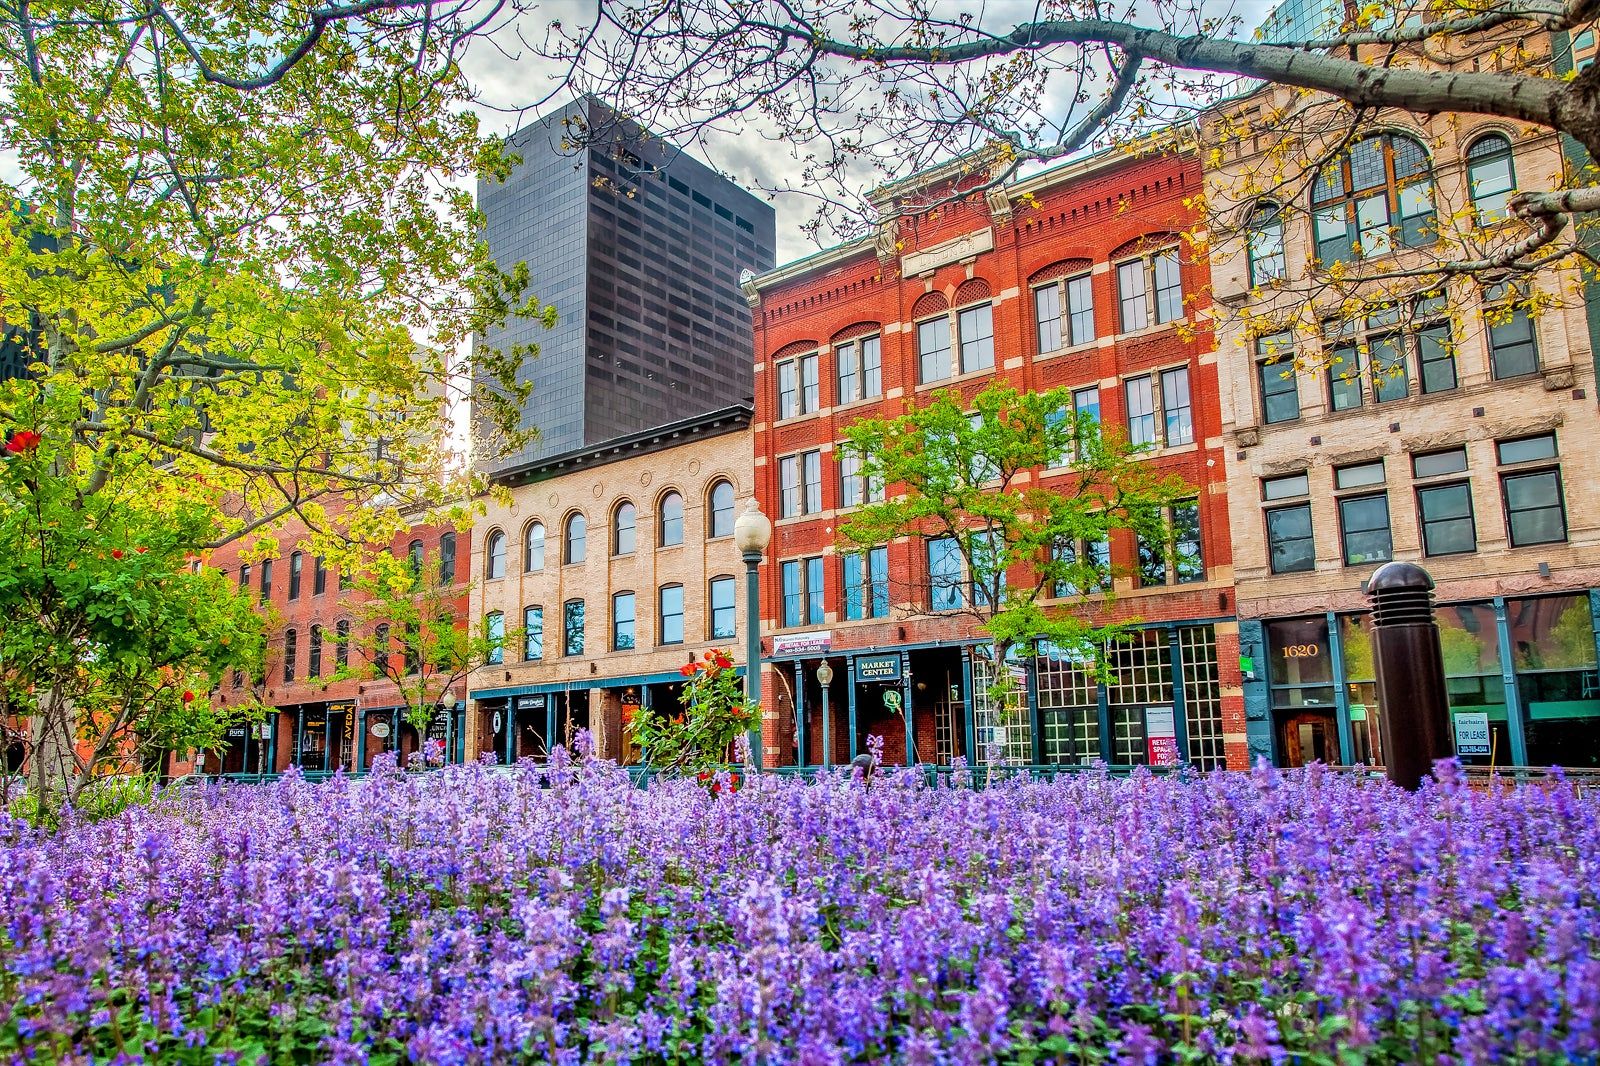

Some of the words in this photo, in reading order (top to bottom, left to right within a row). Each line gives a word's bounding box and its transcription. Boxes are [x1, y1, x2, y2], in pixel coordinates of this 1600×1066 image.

[1281, 643, 1319, 658] 1620
[861, 660, 896, 670] MARKET
[862, 668, 894, 676] CENTER
[344, 706, 354, 740] AVEDA
[1458, 730, 1470, 740] FOR
[1470, 730, 1486, 740] LEASE
